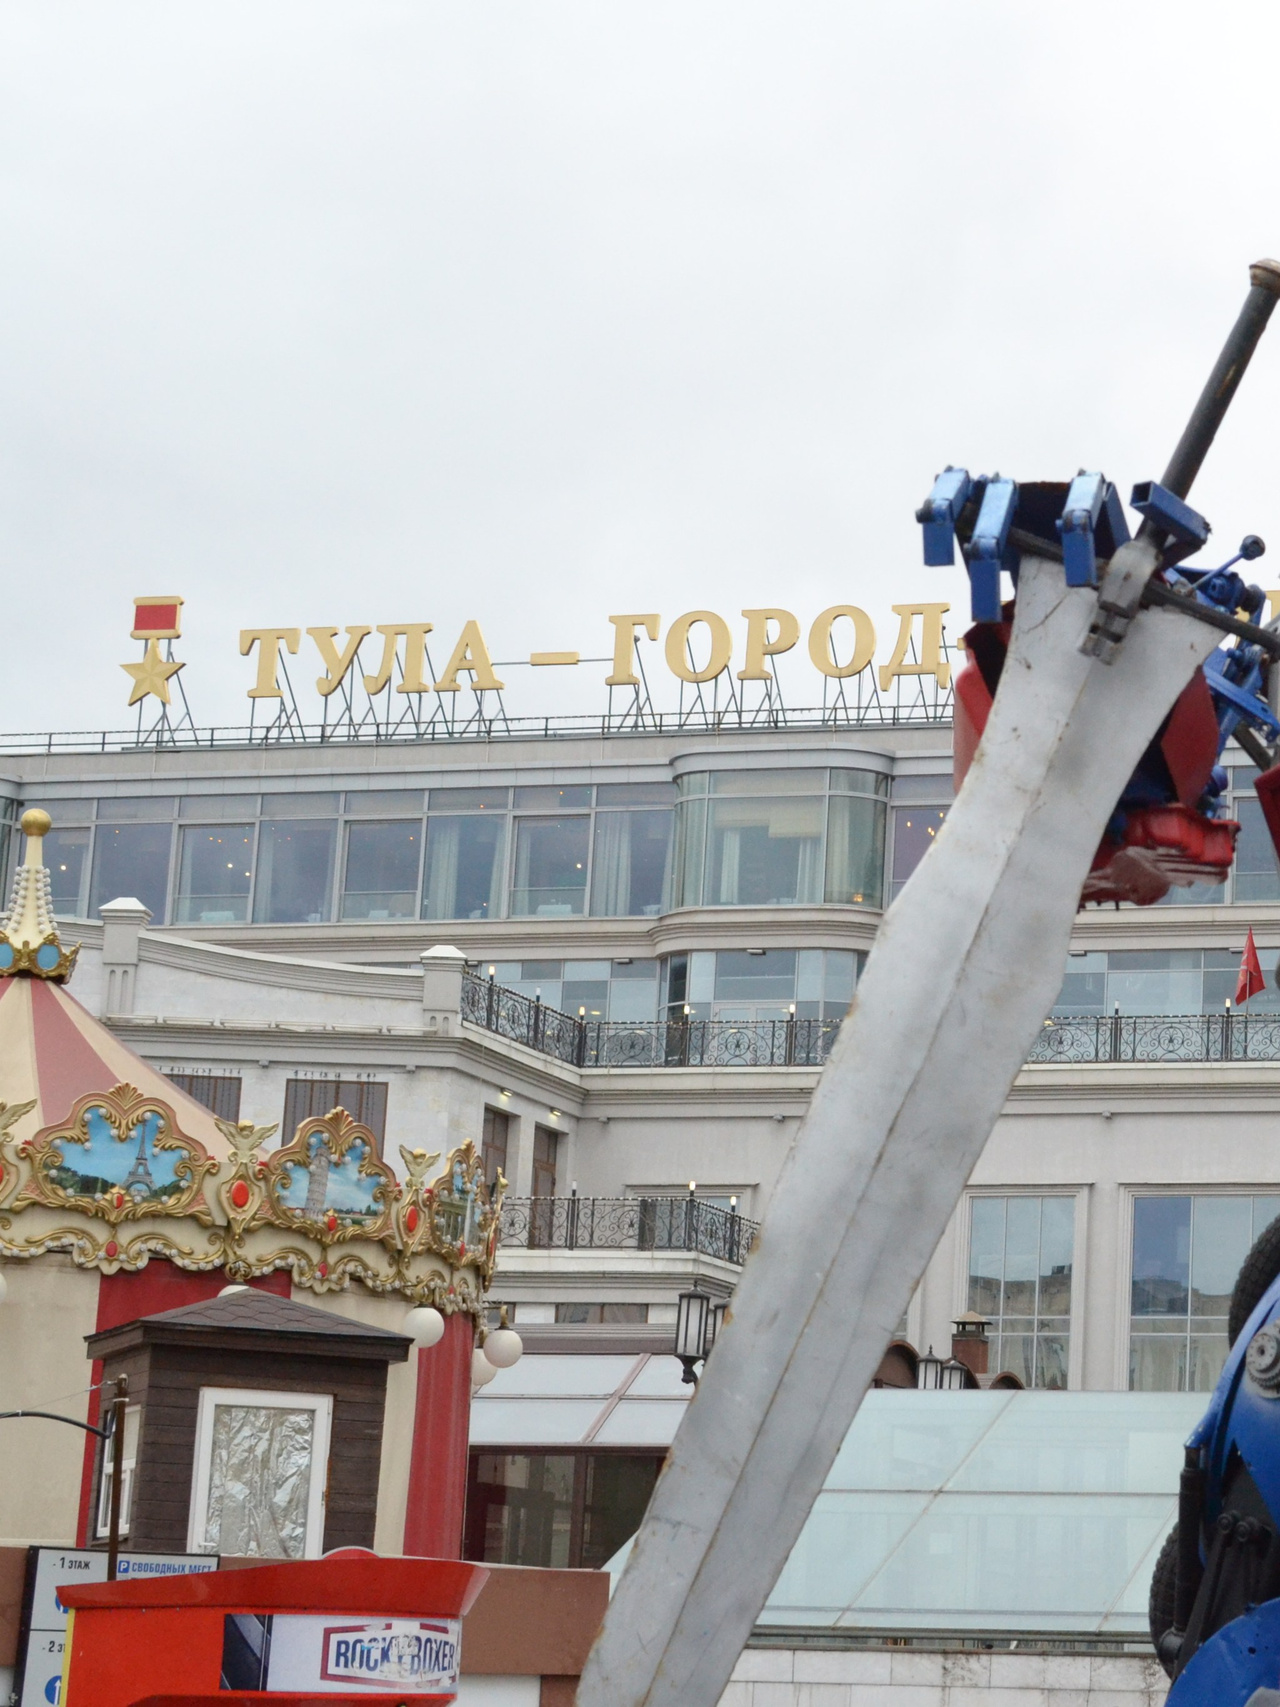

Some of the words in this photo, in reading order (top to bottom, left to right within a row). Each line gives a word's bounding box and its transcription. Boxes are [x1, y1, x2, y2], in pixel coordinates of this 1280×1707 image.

[239, 620, 505, 698] ТУЛА
[605, 602, 952, 692] ГОРОД
[68, 1560, 91, 1570] ЭТАЖ
[132, 1562, 186, 1574] СВОБОДНЫХ
